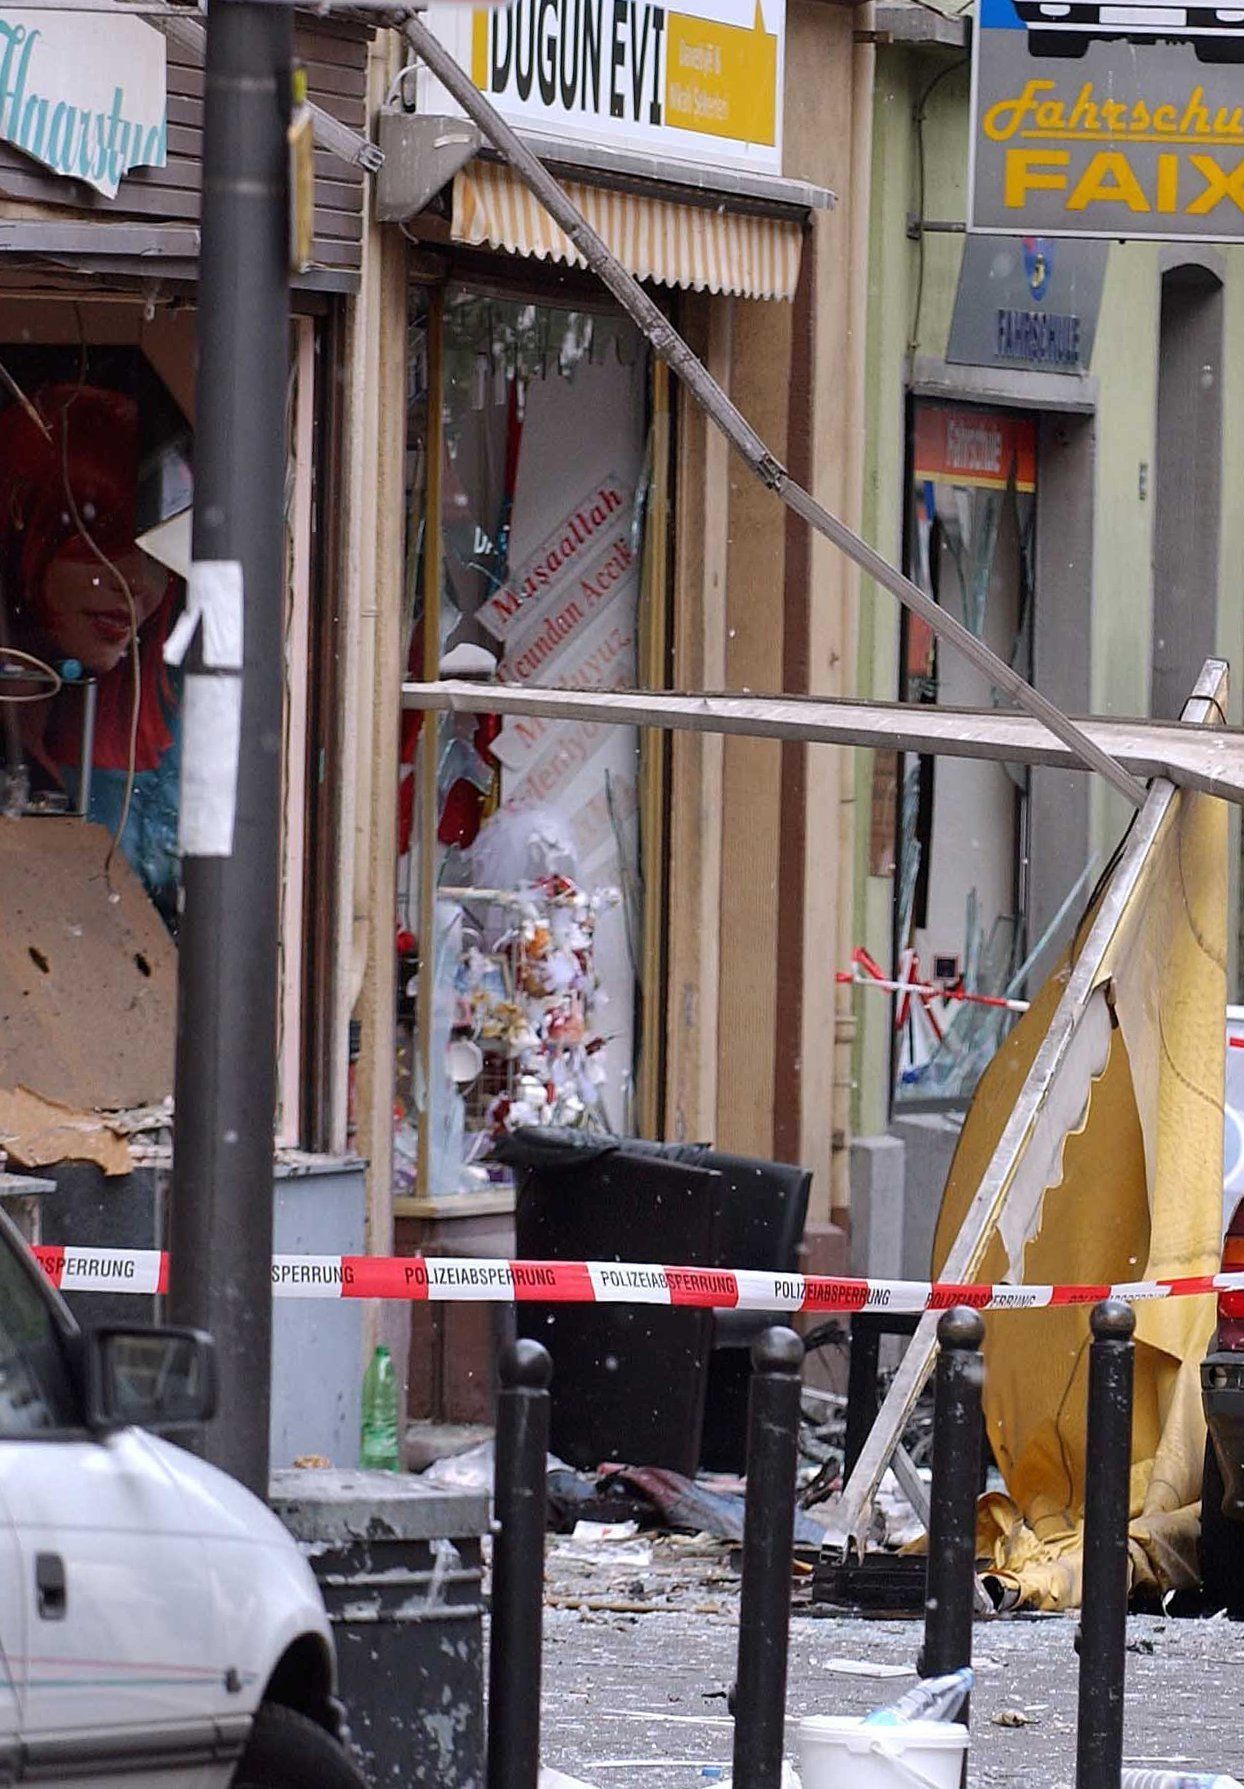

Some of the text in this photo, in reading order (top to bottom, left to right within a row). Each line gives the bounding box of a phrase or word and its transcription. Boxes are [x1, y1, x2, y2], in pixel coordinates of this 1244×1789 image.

[37, 1255, 135, 1278] SPERRUNG
[404, 1266, 556, 1286] POLIZEIABSPERRUNG
[600, 1270, 735, 1294] POLIZEIABSPERRUNG
[775, 1281, 890, 1306] POLIZEIABSPERRUNG
